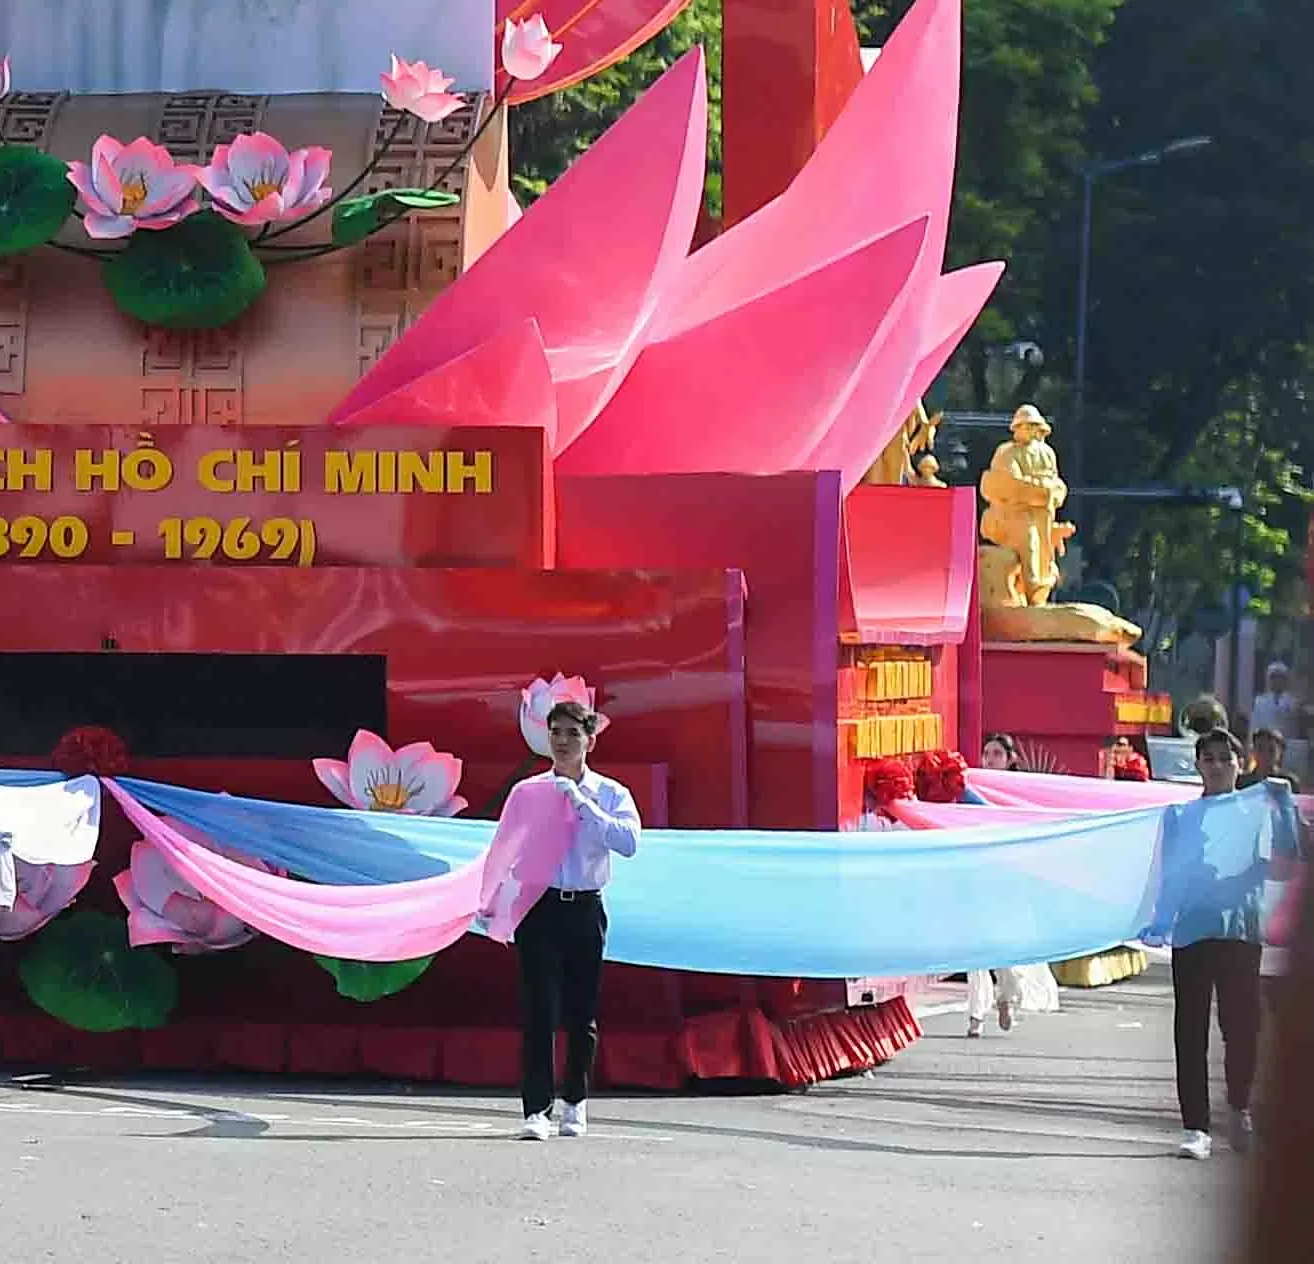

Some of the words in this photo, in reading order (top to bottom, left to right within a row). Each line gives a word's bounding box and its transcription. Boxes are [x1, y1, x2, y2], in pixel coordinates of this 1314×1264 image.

[75, 431, 173, 492] HỒ
[198, 439, 302, 493] CHÍ
[324, 449, 493, 494] MINH
[112, 530, 135, 545] -
[157, 516, 317, 567] 1969)
